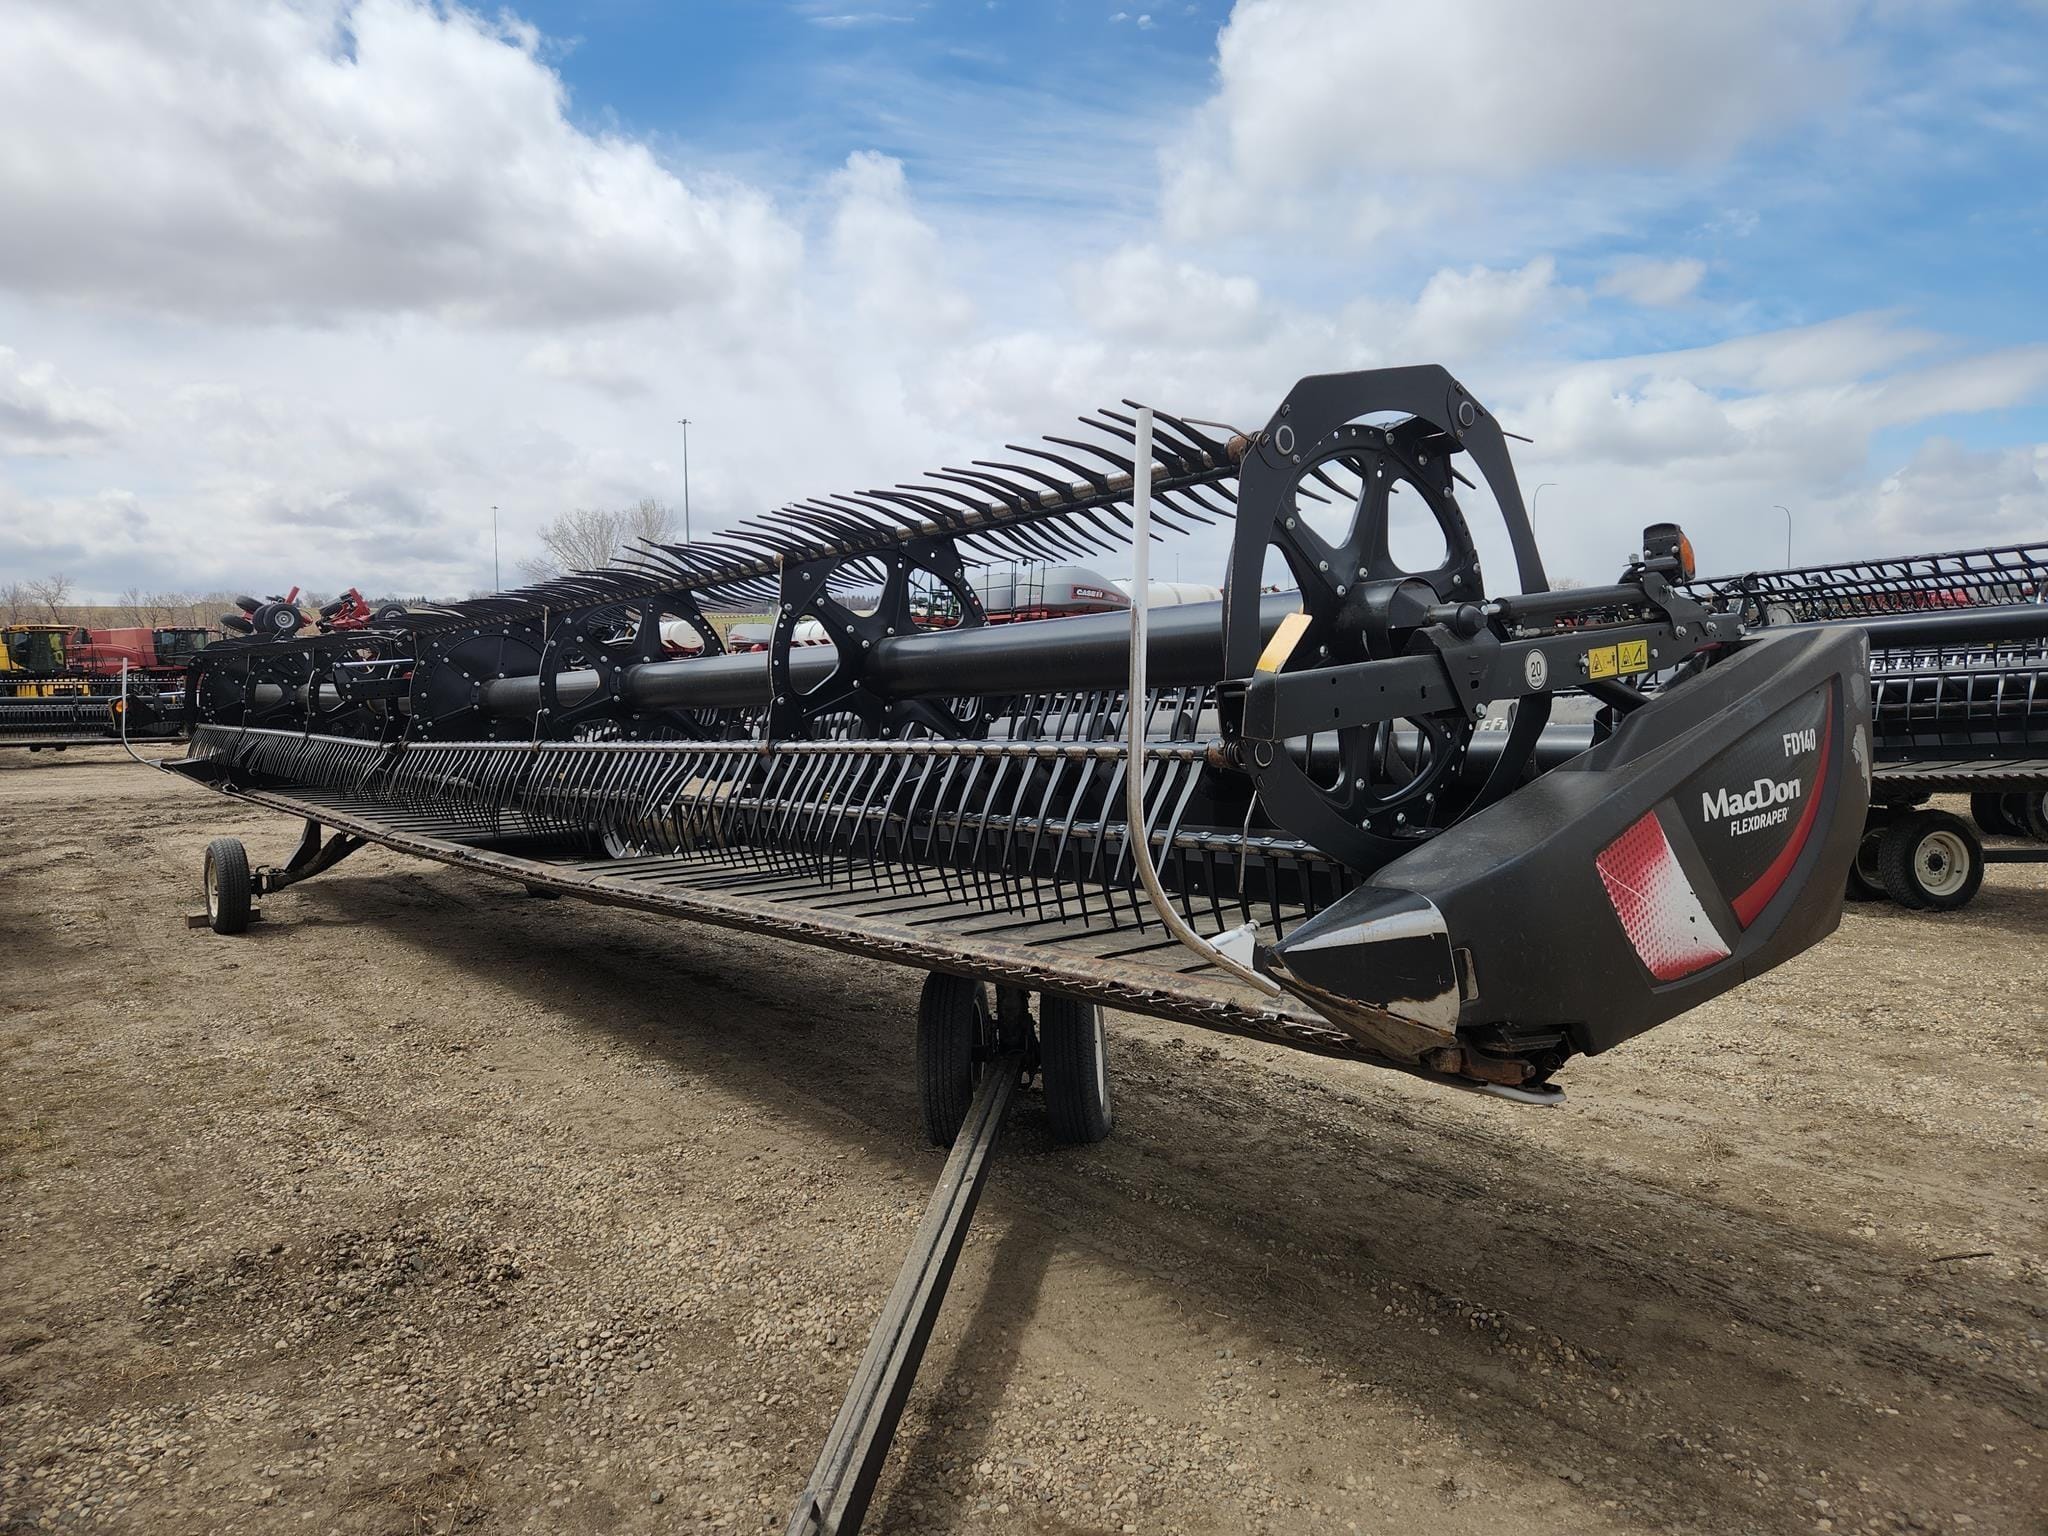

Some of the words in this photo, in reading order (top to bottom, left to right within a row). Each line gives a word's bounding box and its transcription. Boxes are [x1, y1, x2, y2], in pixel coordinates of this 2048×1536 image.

[1530, 660, 1542, 677] 20
[1782, 728, 1816, 757] FD140
[1702, 778, 1801, 822] MacDon
[1730, 807, 1788, 837] FLEXDRAPER
